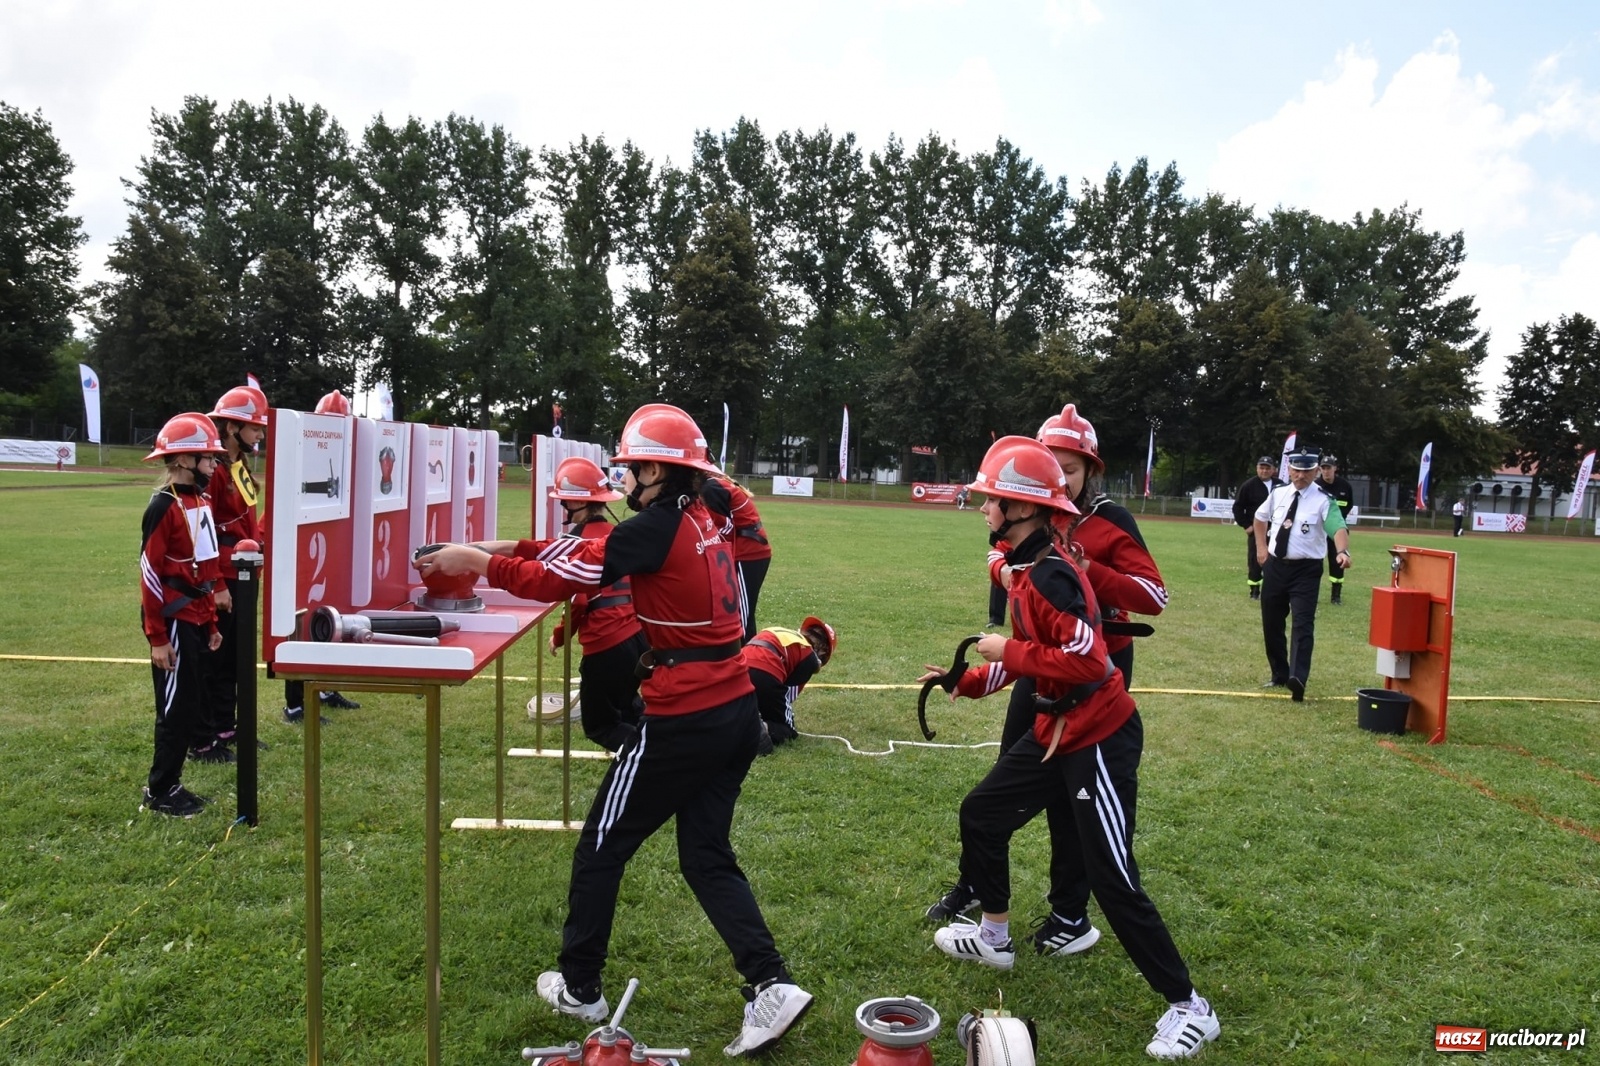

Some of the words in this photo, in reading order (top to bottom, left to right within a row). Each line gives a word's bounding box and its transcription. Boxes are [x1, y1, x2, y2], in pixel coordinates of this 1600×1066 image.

[238, 466, 255, 501] 6
[199, 511, 217, 553] 1
[376, 519, 391, 581] 3
[307, 531, 327, 603] 2
[716, 549, 738, 614] 3
